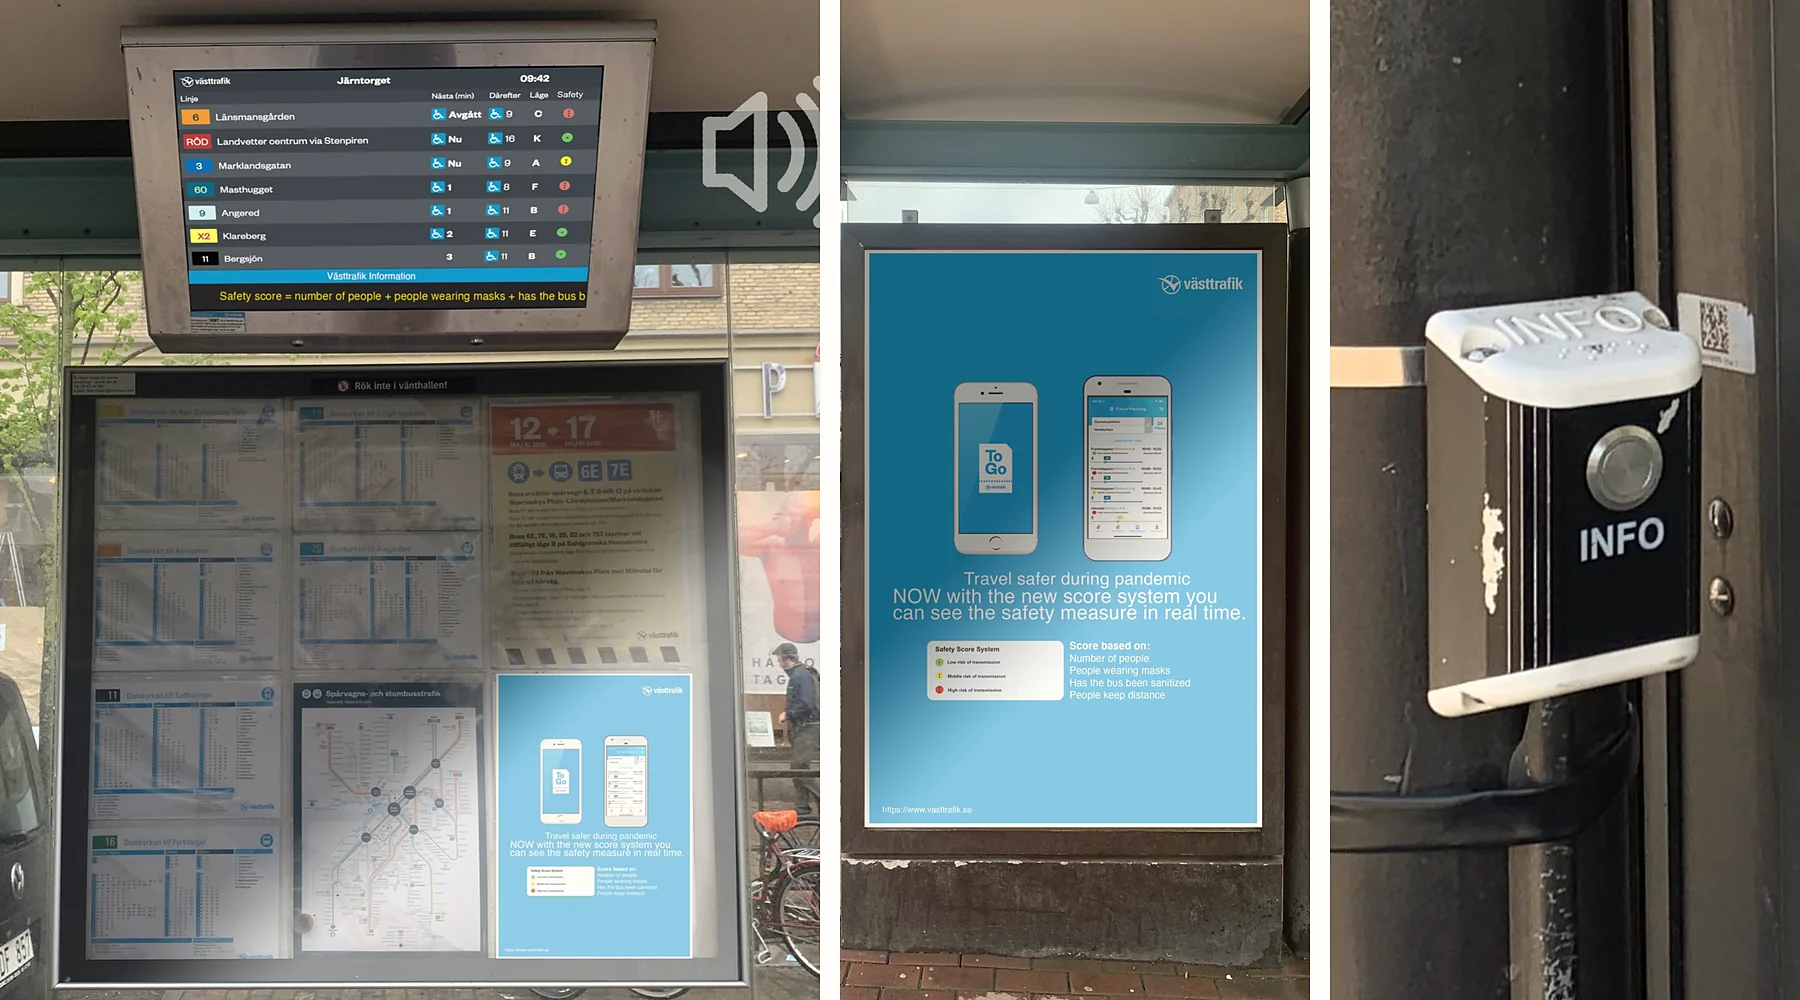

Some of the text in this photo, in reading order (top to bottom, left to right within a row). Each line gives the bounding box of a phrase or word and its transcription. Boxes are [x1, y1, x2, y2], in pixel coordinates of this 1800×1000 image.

[195, 77, 231, 85] västtrafik
[337, 76, 391, 85] Järntorget
[520, 74, 550, 83] 09:42
[530, 92, 549, 100] Läge
[557, 91, 584, 100] Safety
[215, 113, 295, 122] Länsmansgården
[448, 110, 482, 120] Avgått
[186, 136, 209, 146] RÖD
[217, 137, 267, 146] Landvetter
[324, 137, 368, 146] Stenpiren
[218, 162, 291, 171] Marklandsgatan
[220, 186, 273, 195] Masthugget
[222, 209, 260, 219] Angered
[223, 232, 266, 241] Klareberg
[224, 255, 263, 264] Bergsjön
[327, 272, 416, 281] Västtrafik Information
[1184, 277, 1243, 290] västtrafik
[220, 291, 251, 302] Safety
[254, 292, 282, 300] score
[294, 291, 332, 300] number
[335, 291, 346, 300] of
[348, 292, 381, 303] people
[395, 292, 428, 303] people
[431, 292, 470, 302] wearing
[474, 292, 505, 300] masks
[518, 292, 536, 300] has
[539, 292, 555, 300] the
[558, 292, 576, 300] bus
[1494, 305, 1644, 346] INFO
[355, 382, 371, 390] Rök
[374, 382, 390, 390] inte
[399, 381, 448, 390] vänthallen!
[510, 416, 596, 440] 12 17
[985, 450, 1002, 462] To
[582, 463, 629, 479] 6E 7E
[985, 463, 1007, 475] Go
[1580, 517, 1664, 562] INFO
[964, 572, 1190, 588] Travel safer during pandemic
[893, 588, 1217, 607] NOW with the new score system you
[893, 605, 1246, 623] can see the safety measure in real time.
[1070, 641, 1098, 650] Score
[1101, 641, 1131, 650] based
[1108, 654, 1116, 662] of
[1119, 654, 1149, 664] people
[1070, 667, 1100, 676] People
[1103, 667, 1138, 676] wearing
[1070, 679, 1190, 687] Has the bus been sanitized
[108, 691, 117, 700] 11
[1070, 691, 1100, 700] People
[1103, 691, 1125, 700] keep
[882, 806, 972, 814] https://www.vasttrafik.se
[545, 832, 657, 841] Travel safer during pandemic
[105, 837, 115, 846] 16
[124, 839, 161, 847] Domkyrkan
[510, 840, 534, 849] NOW
[536, 840, 554, 849] with
[557, 840, 571, 849] the
[621, 841, 652, 850] system
[654, 842, 670, 850] you
[547, 849, 561, 857] the
[564, 849, 590, 858] safety
[634, 849, 641, 857] in
[644, 849, 660, 857] real
[663, 849, 684, 857] time.
